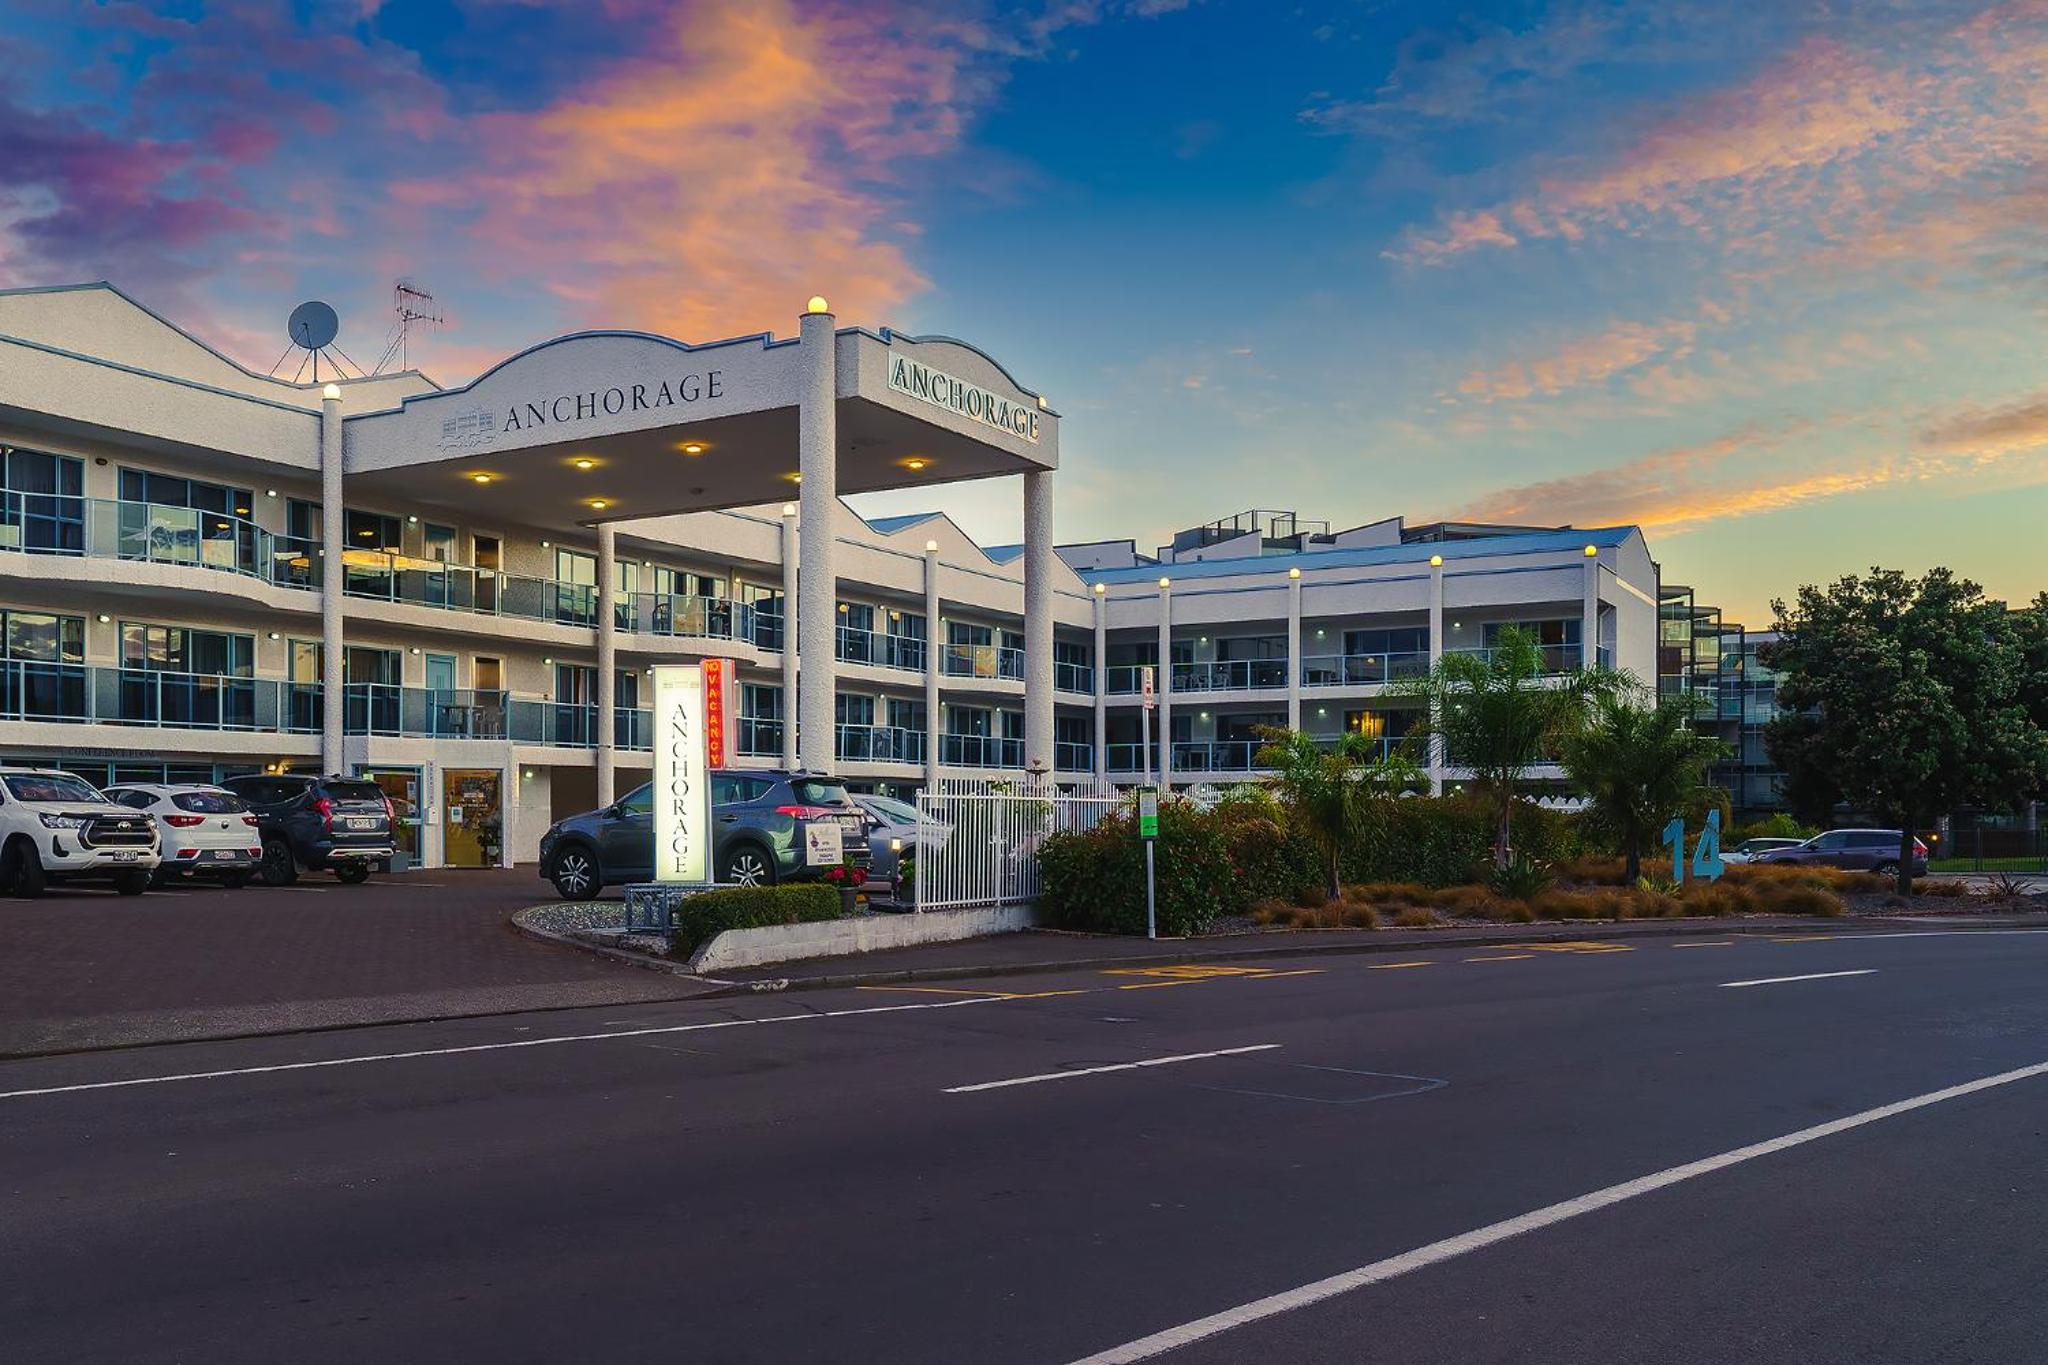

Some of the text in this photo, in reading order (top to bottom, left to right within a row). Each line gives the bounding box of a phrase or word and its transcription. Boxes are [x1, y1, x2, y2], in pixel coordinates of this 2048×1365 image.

[502, 369, 725, 433] ANCHORAGE
[890, 355, 1040, 440] ANCHORAGE
[705, 661, 719, 672] NO
[708, 674, 719, 765] VACANCY
[671, 703, 689, 874] ANCHORAGE
[1662, 808, 1724, 882] 14
